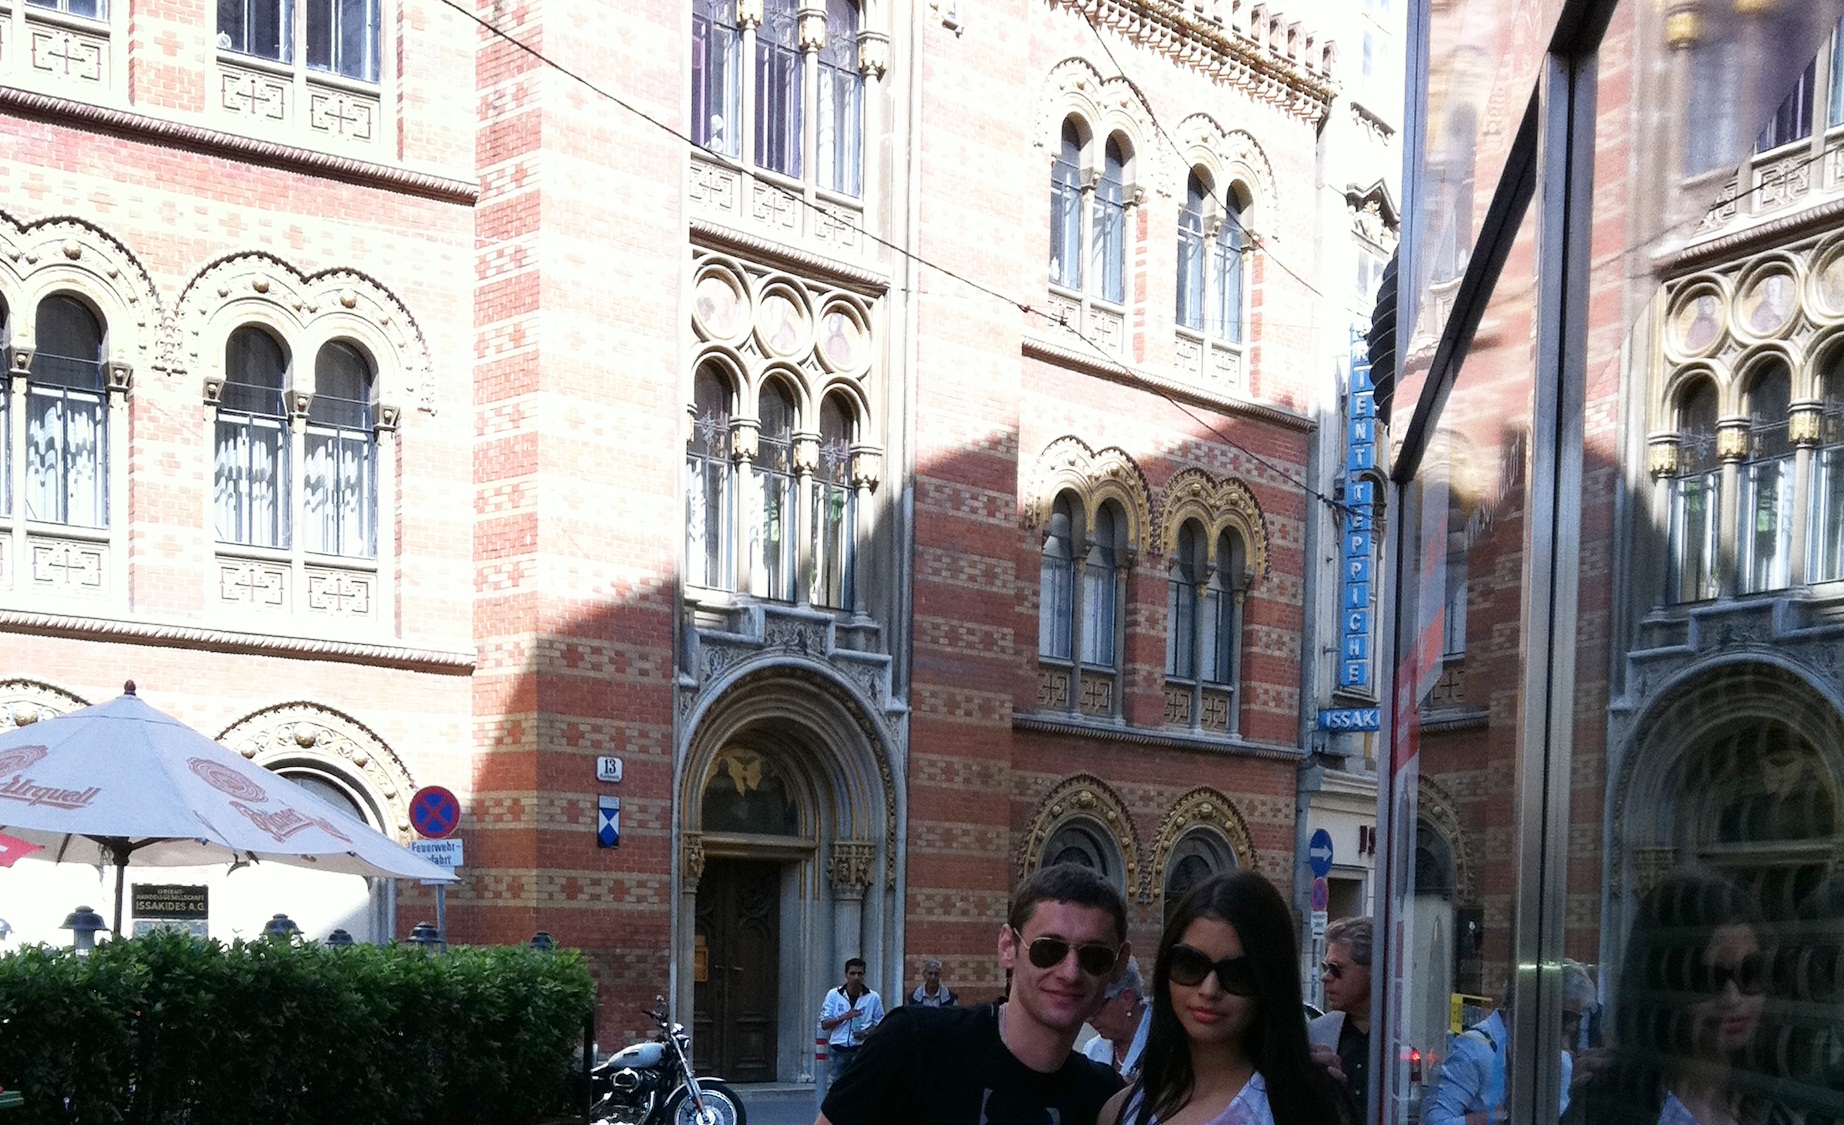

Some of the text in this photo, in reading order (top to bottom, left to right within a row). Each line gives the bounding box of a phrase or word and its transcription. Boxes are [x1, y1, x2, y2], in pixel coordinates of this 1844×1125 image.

[1349, 484, 1365, 682] TEPPICHE
[604, 758, 616, 774] 13
[136, 901, 187, 911] ISSAKIDES
